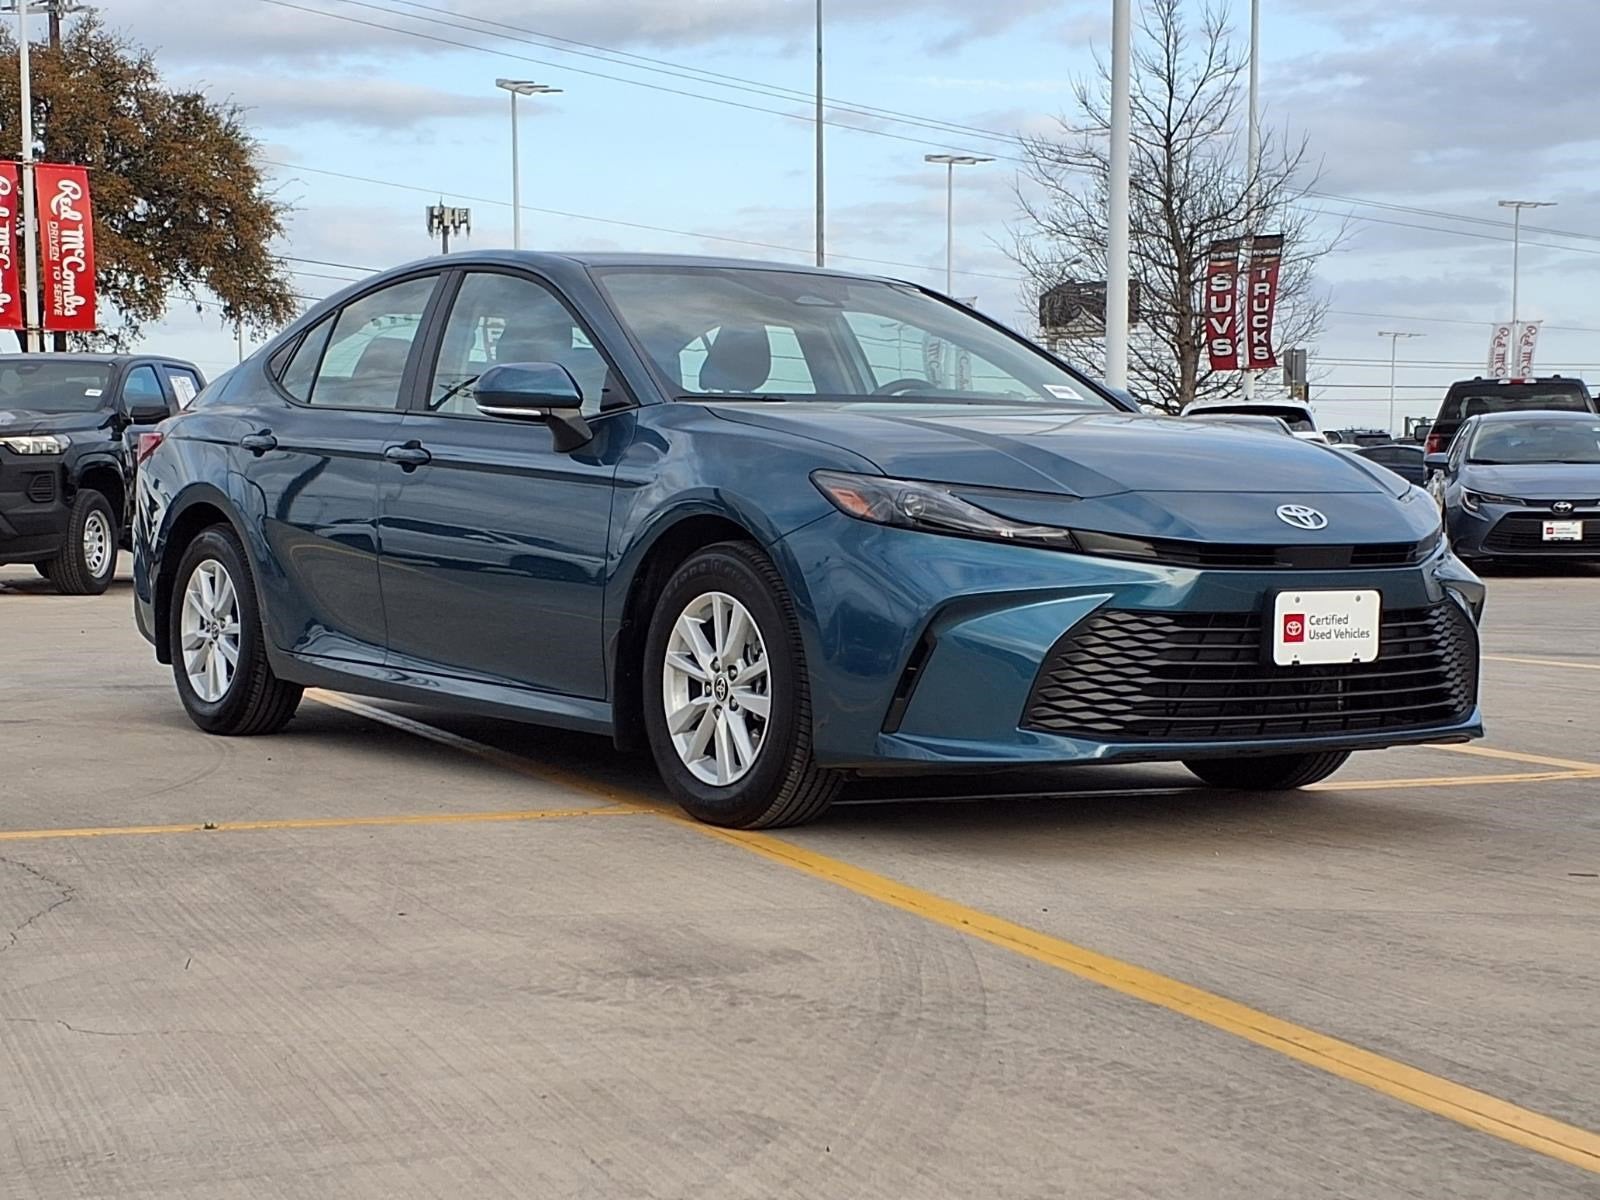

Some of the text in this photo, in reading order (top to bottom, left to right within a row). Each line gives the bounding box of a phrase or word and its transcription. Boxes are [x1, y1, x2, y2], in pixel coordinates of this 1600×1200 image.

[49, 221, 63, 317] DRIVEN TO SERVE
[50, 179, 87, 317] Red McCombs
[1209, 273, 1233, 356] SUVS
[1252, 267, 1272, 360] TRUCKS
[1309, 613, 1349, 626] Certified
[1309, 627, 1370, 640] Used Vehicles
